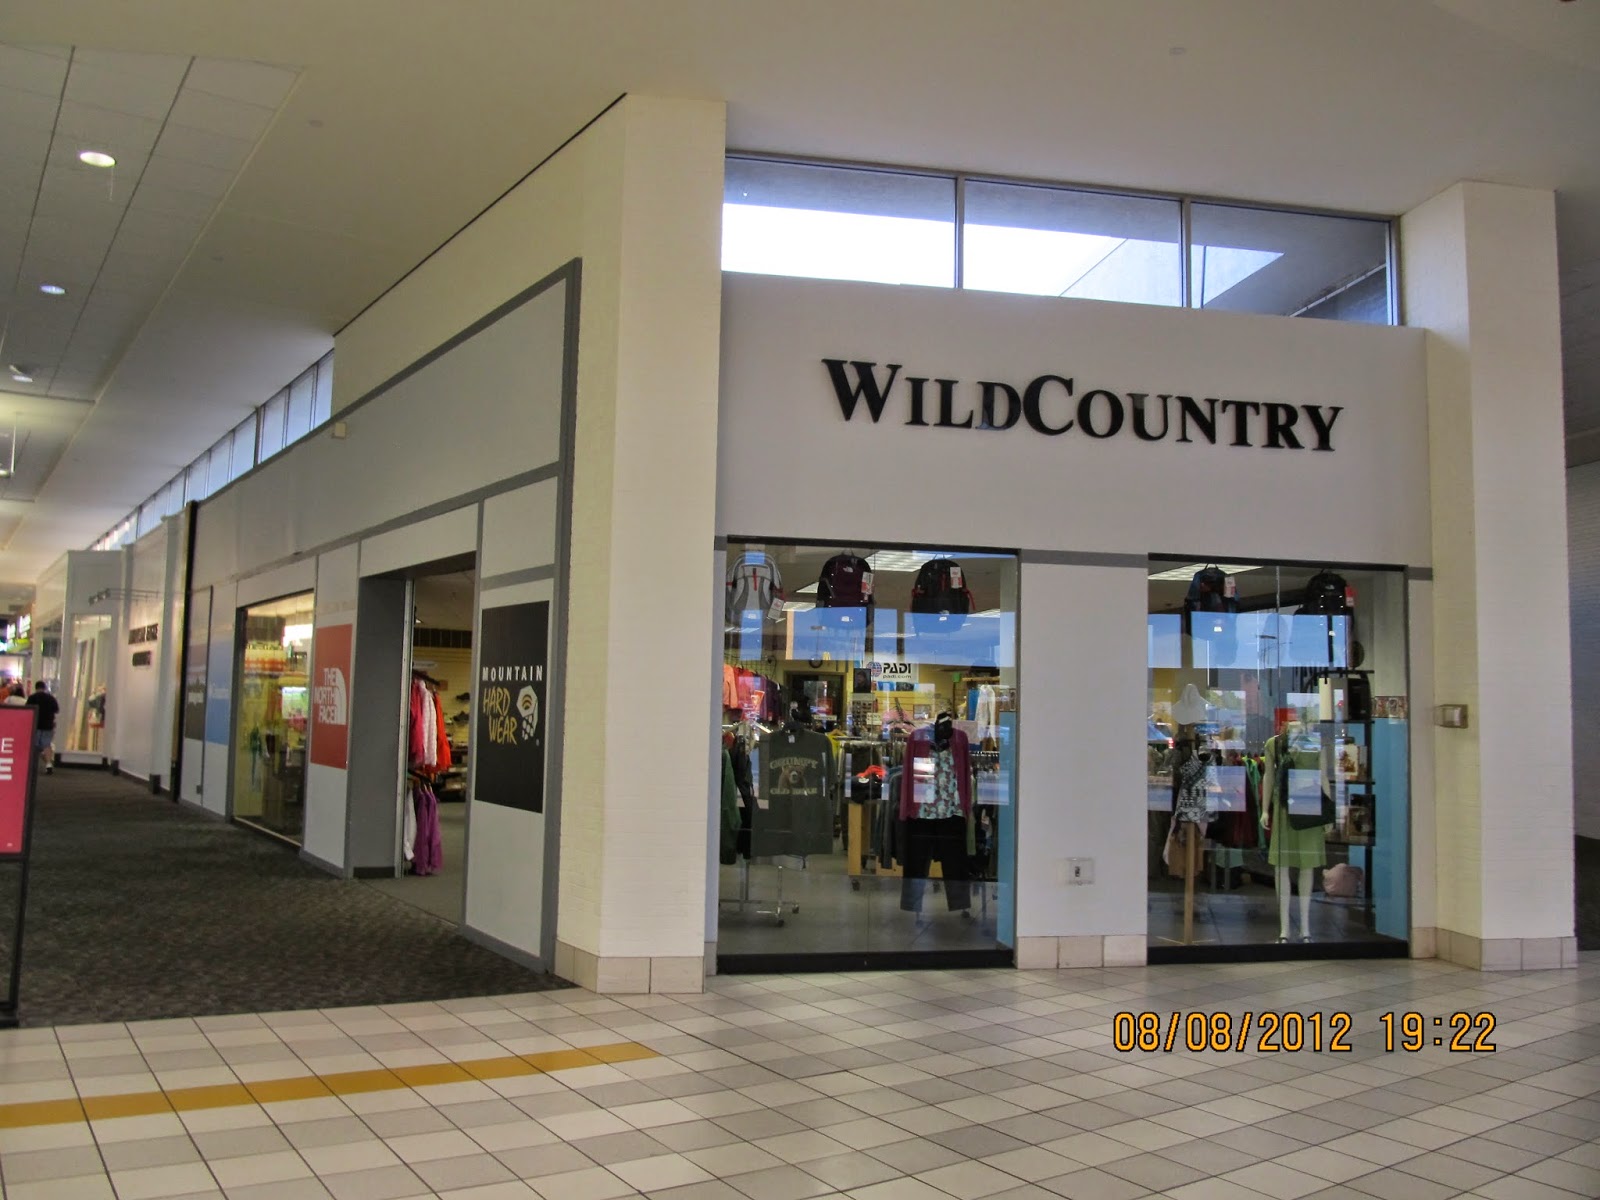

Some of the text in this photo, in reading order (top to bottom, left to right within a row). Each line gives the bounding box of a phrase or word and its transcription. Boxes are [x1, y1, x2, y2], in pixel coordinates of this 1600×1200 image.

[323, 667, 338, 687] THE
[482, 665, 543, 682] MOUNTAIN
[883, 662, 912, 674] PADI
[314, 686, 337, 706] NORTH
[483, 686, 511, 717] HARD
[318, 704, 338, 725] FACE
[488, 714, 518, 745] WEAR
